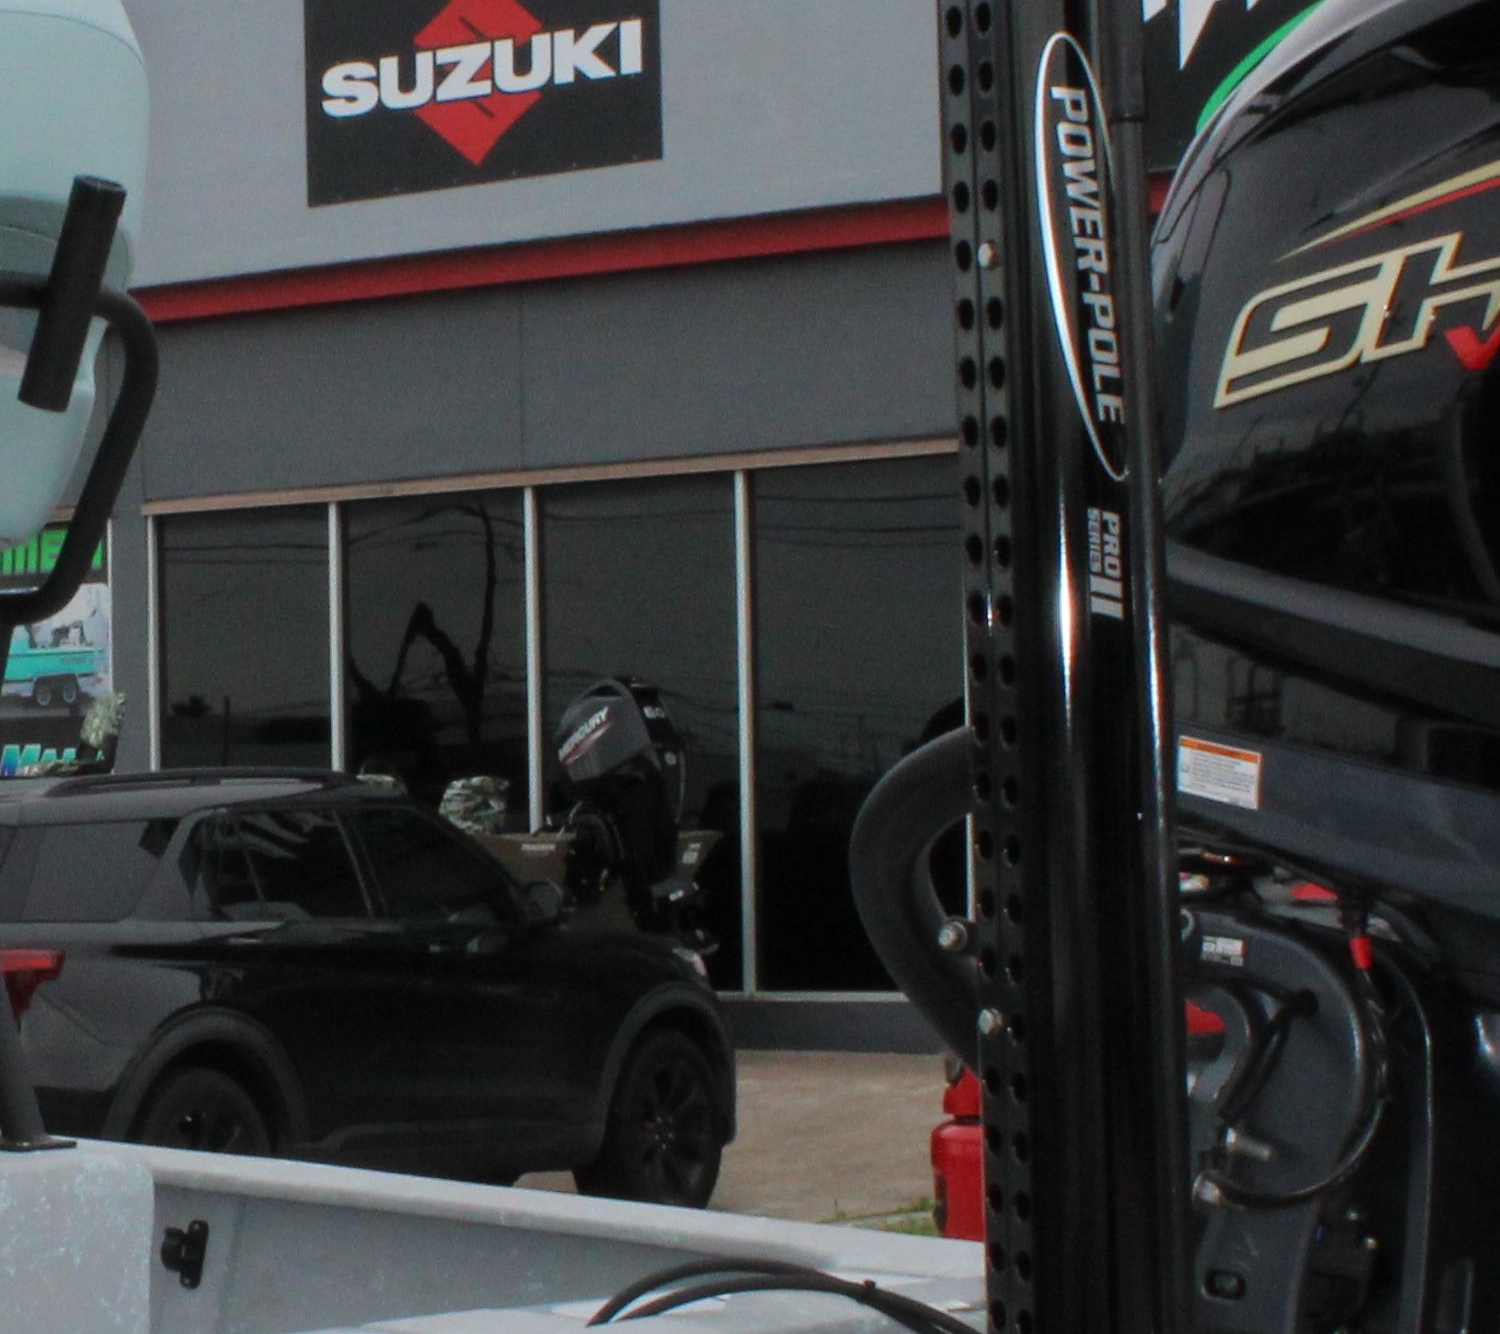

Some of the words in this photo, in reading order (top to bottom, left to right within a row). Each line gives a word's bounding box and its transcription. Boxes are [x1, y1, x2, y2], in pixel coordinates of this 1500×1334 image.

[320, 17, 643, 117] SUZUKI
[1048, 84, 1125, 426] POWER-POLE
[1101, 510, 1122, 581] PRO
